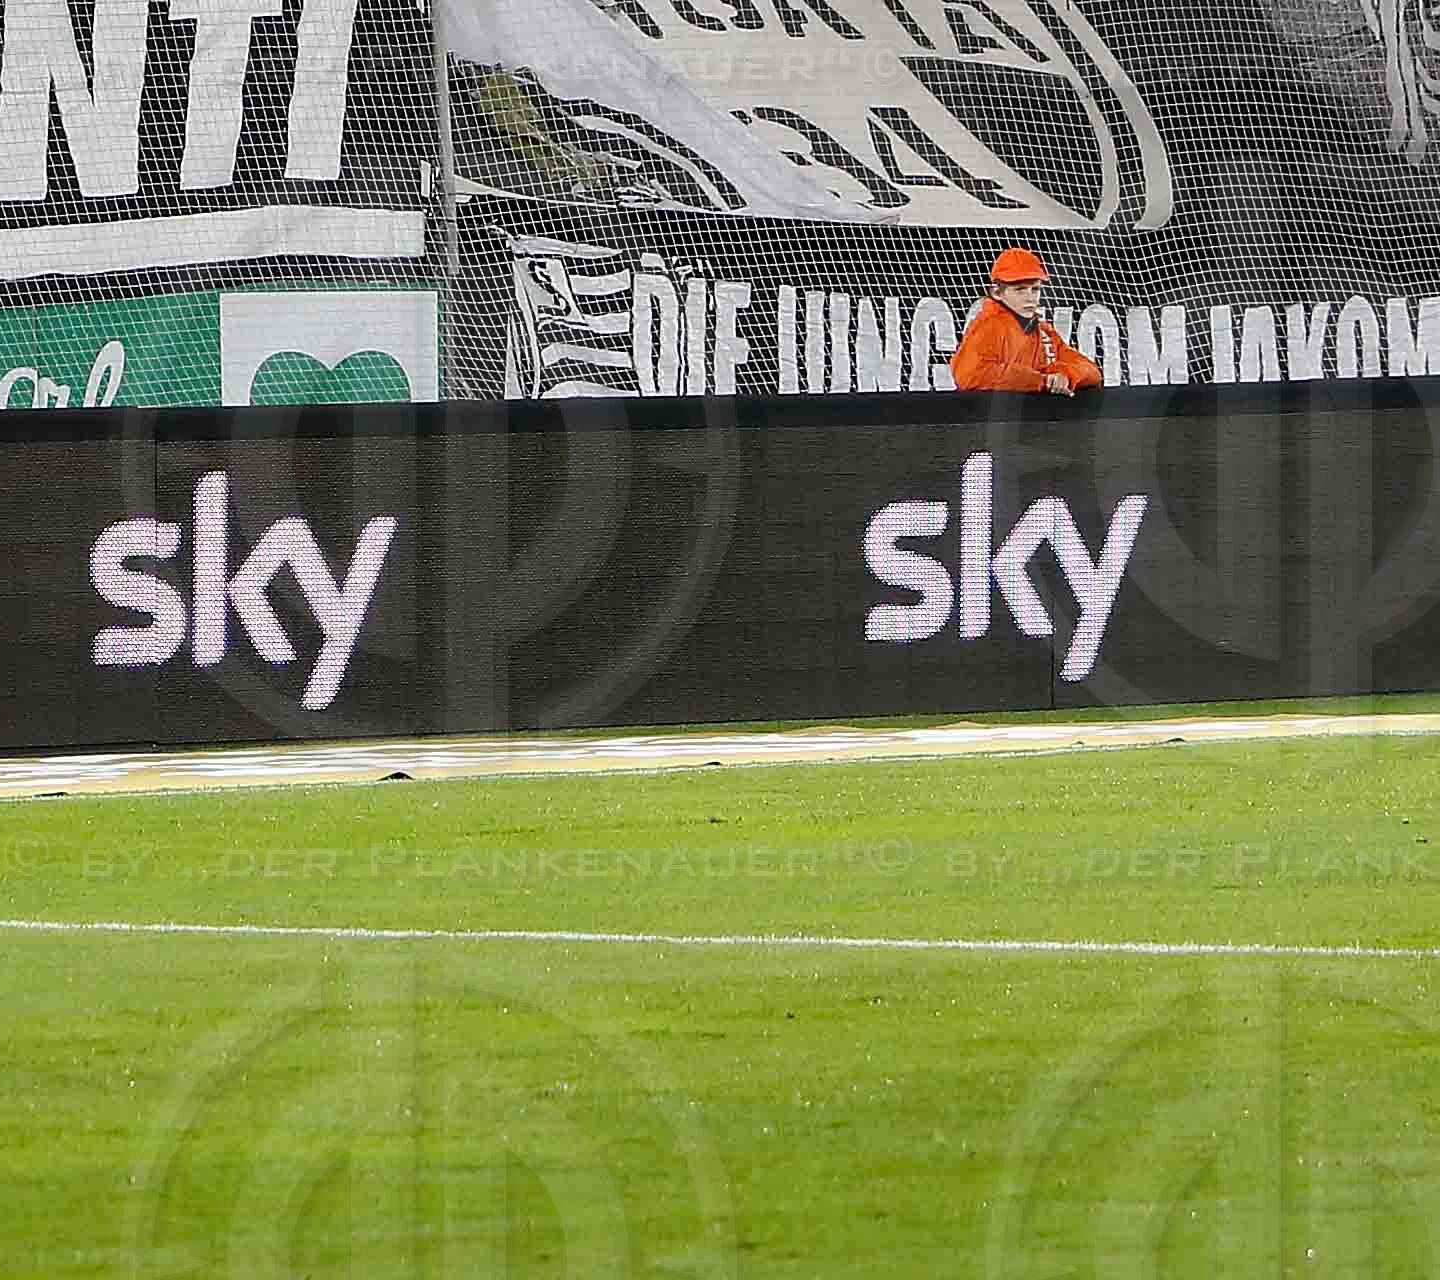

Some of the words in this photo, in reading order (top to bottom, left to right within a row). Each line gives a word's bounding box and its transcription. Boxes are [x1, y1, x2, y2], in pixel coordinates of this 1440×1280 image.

[778, 283, 982, 395] JUNG
[89, 469, 398, 712] sky
[863, 451, 1152, 683] sky
